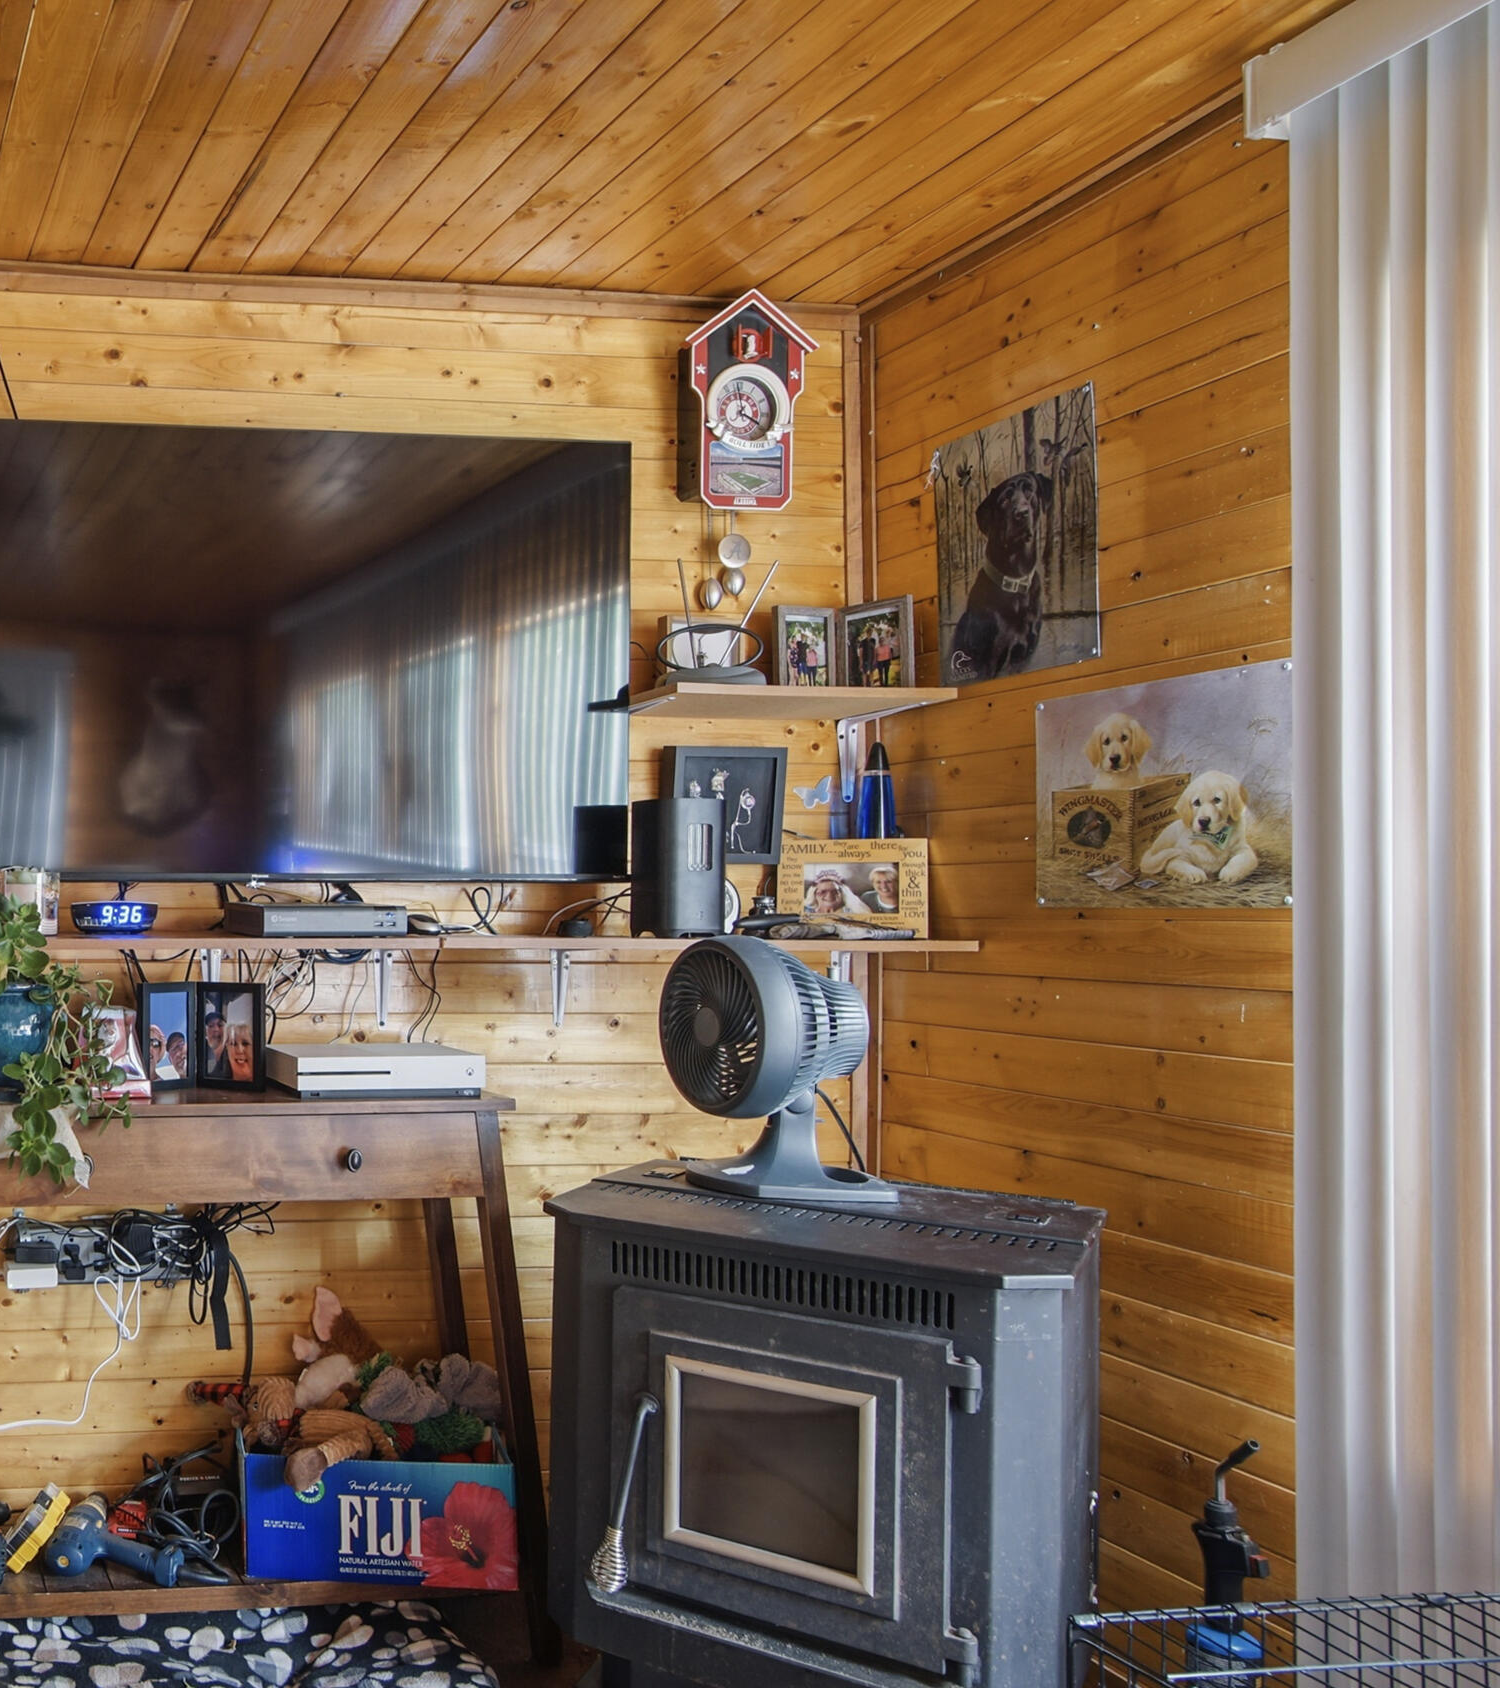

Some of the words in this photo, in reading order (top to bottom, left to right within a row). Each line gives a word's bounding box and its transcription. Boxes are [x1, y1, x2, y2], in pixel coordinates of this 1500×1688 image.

[838, 849, 872, 861] always
[870, 841, 898, 850] there
[905, 869, 927, 877] thick
[907, 876, 920, 889] &
[901, 888, 922, 898] thin
[102, 905, 143, 924] 9:36
[337, 1494, 424, 1558] FIJI
[338, 1557, 368, 1566] NATURAL
[369, 1558, 401, 1567] ARTESIAN
[401, 1560, 424, 1568] WATER
